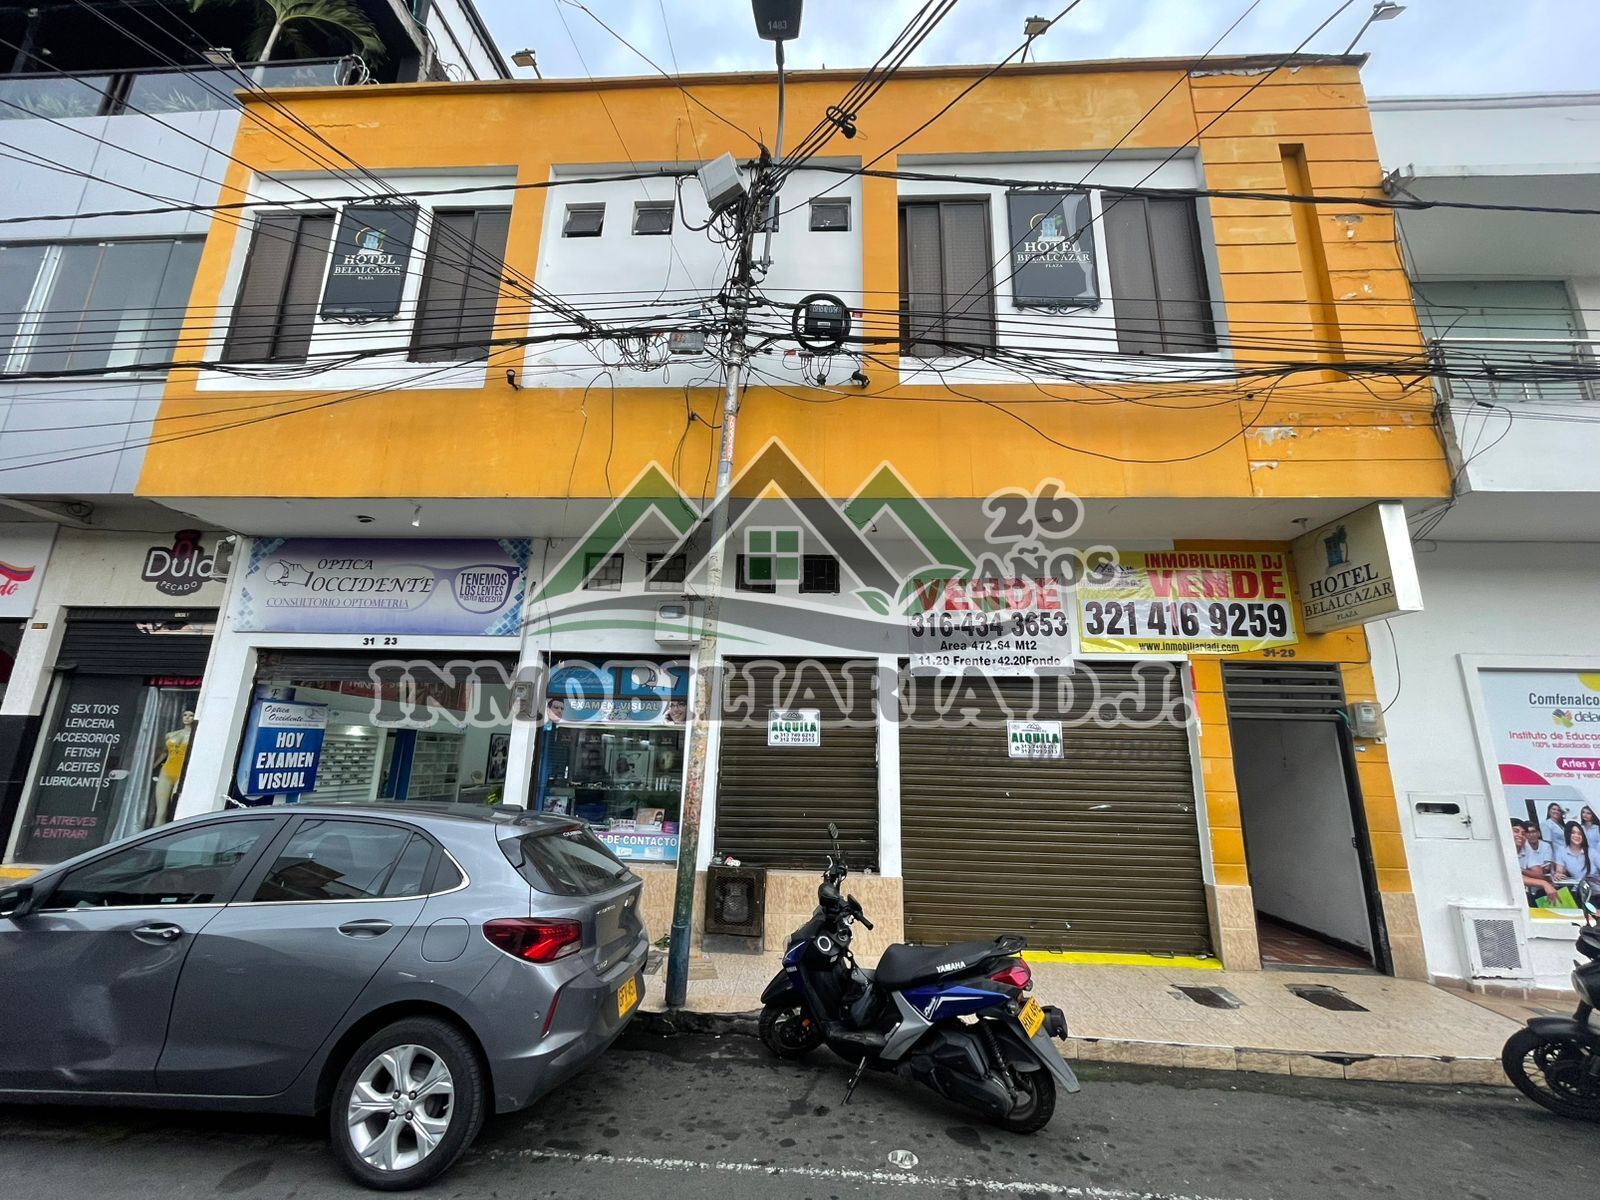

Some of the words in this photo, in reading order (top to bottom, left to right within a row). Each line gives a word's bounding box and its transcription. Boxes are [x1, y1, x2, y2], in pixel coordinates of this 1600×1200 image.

[1024, 242, 1081, 252] HOTEL
[343, 254, 396, 265] HOTEL
[1017, 253, 1090, 262] BELALCAZAR
[334, 266, 401, 274] BELALCAZAR
[145, 550, 214, 577] Dulc
[317, 558, 374, 570] OPTICA
[1144, 553, 1257, 569] INMOBILIARIA
[1261, 555, 1283, 569] DJ
[311, 576, 434, 593] OCCIDENTE
[460, 573, 508, 586] TENEMOS
[1147, 570, 1286, 599] VENDE
[1309, 563, 1379, 598] HOTEL
[160, 580, 198, 591] PECADO
[460, 586, 476, 596] LOS
[477, 586, 504, 596] LENTES
[913, 578, 1062, 611] VENDE
[1304, 582, 1393, 617] BELALCAZAR
[1085, 601, 1138, 635] 321
[1147, 602, 1200, 635] 416
[1208, 602, 1288, 637] 9259
[1336, 611, 1359, 620] PLAZA
[911, 612, 1004, 637] 316-434
[1011, 612, 1068, 637] 3653
[362, 637, 376, 646] 31
[383, 637, 398, 646] 23
[940, 640, 967, 650] Area
[1015, 640, 1038, 650] Mt2
[918, 656, 950, 666] 11.20
[1529, 692, 1600, 706] Comfenalco
[70, 704, 91, 713] SEX
[93, 704, 120, 715] TOYS
[571, 701, 614, 710] EXAMEN
[620, 702, 660, 711] VISUAL
[1574, 710, 1600, 722] dela
[65, 719, 115, 728] LENCERIA
[771, 722, 817, 732] ALQUILA
[53, 733, 120, 743] ACCESORIOS
[276, 732, 304, 748] HOY
[1012, 733, 1060, 744] ALQUILA
[1509, 731, 1547, 740] Instituto
[1550, 732, 1563, 740] de
[64, 748, 101, 758] FETISH
[256, 752, 315, 769] EXAMEN
[1562, 760, 1587, 768] Artes
[57, 763, 100, 773] ACEITES
[40, 776, 110, 788] LUBRICANTES
[258, 772, 305, 790] VISUAL
[35, 816, 49, 825] TE
[50, 816, 97, 827] ATREVES
[33, 830, 41, 838] A
[43, 829, 88, 839] ENTRAR!
[607, 835, 620, 844] DE
[623, 835, 677, 847] CONTACTO
[936, 961, 966, 974] YAMAHA
